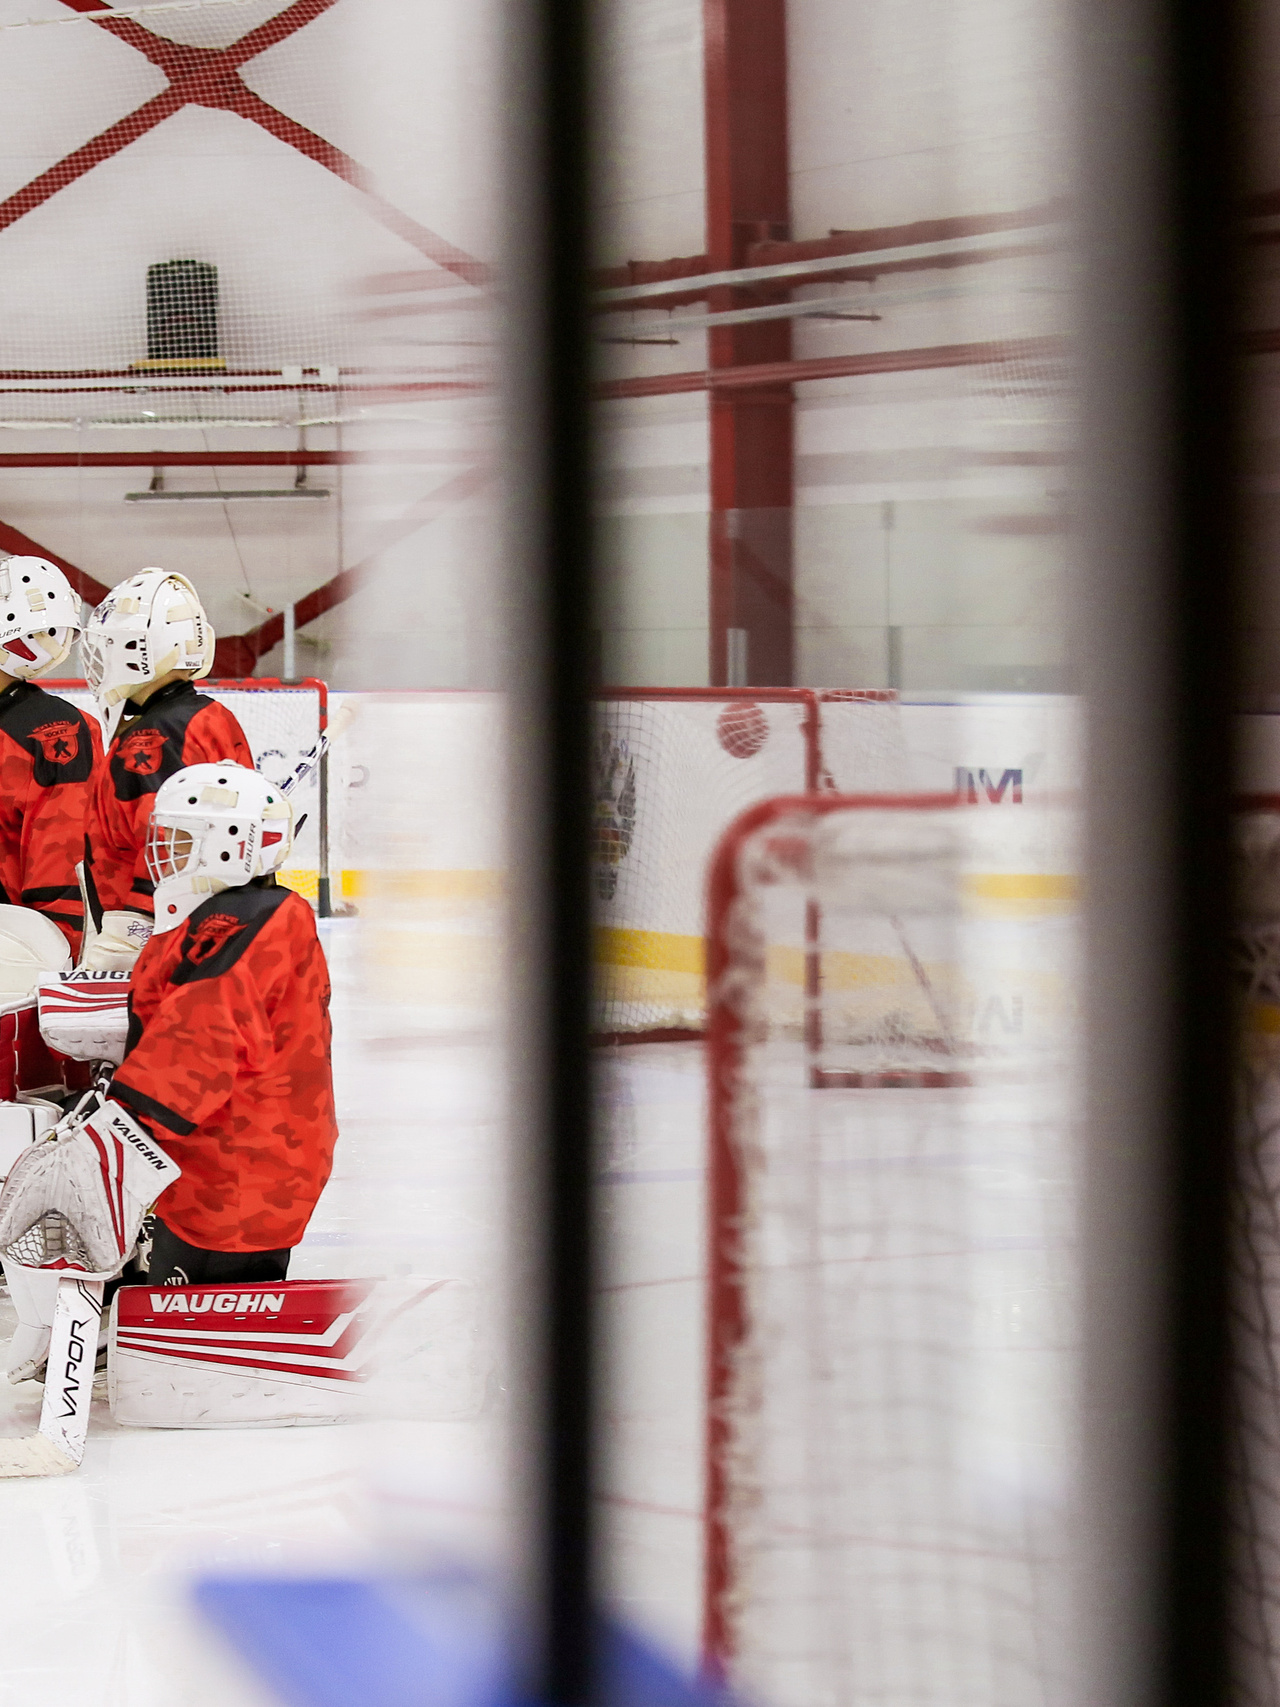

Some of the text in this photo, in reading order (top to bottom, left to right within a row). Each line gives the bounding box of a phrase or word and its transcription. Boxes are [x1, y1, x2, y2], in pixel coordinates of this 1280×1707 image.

[112, 1117, 168, 1170] VAUGHN
[149, 1293, 286, 1314] VAUGHN
[56, 1316, 94, 1418] VAPOR
